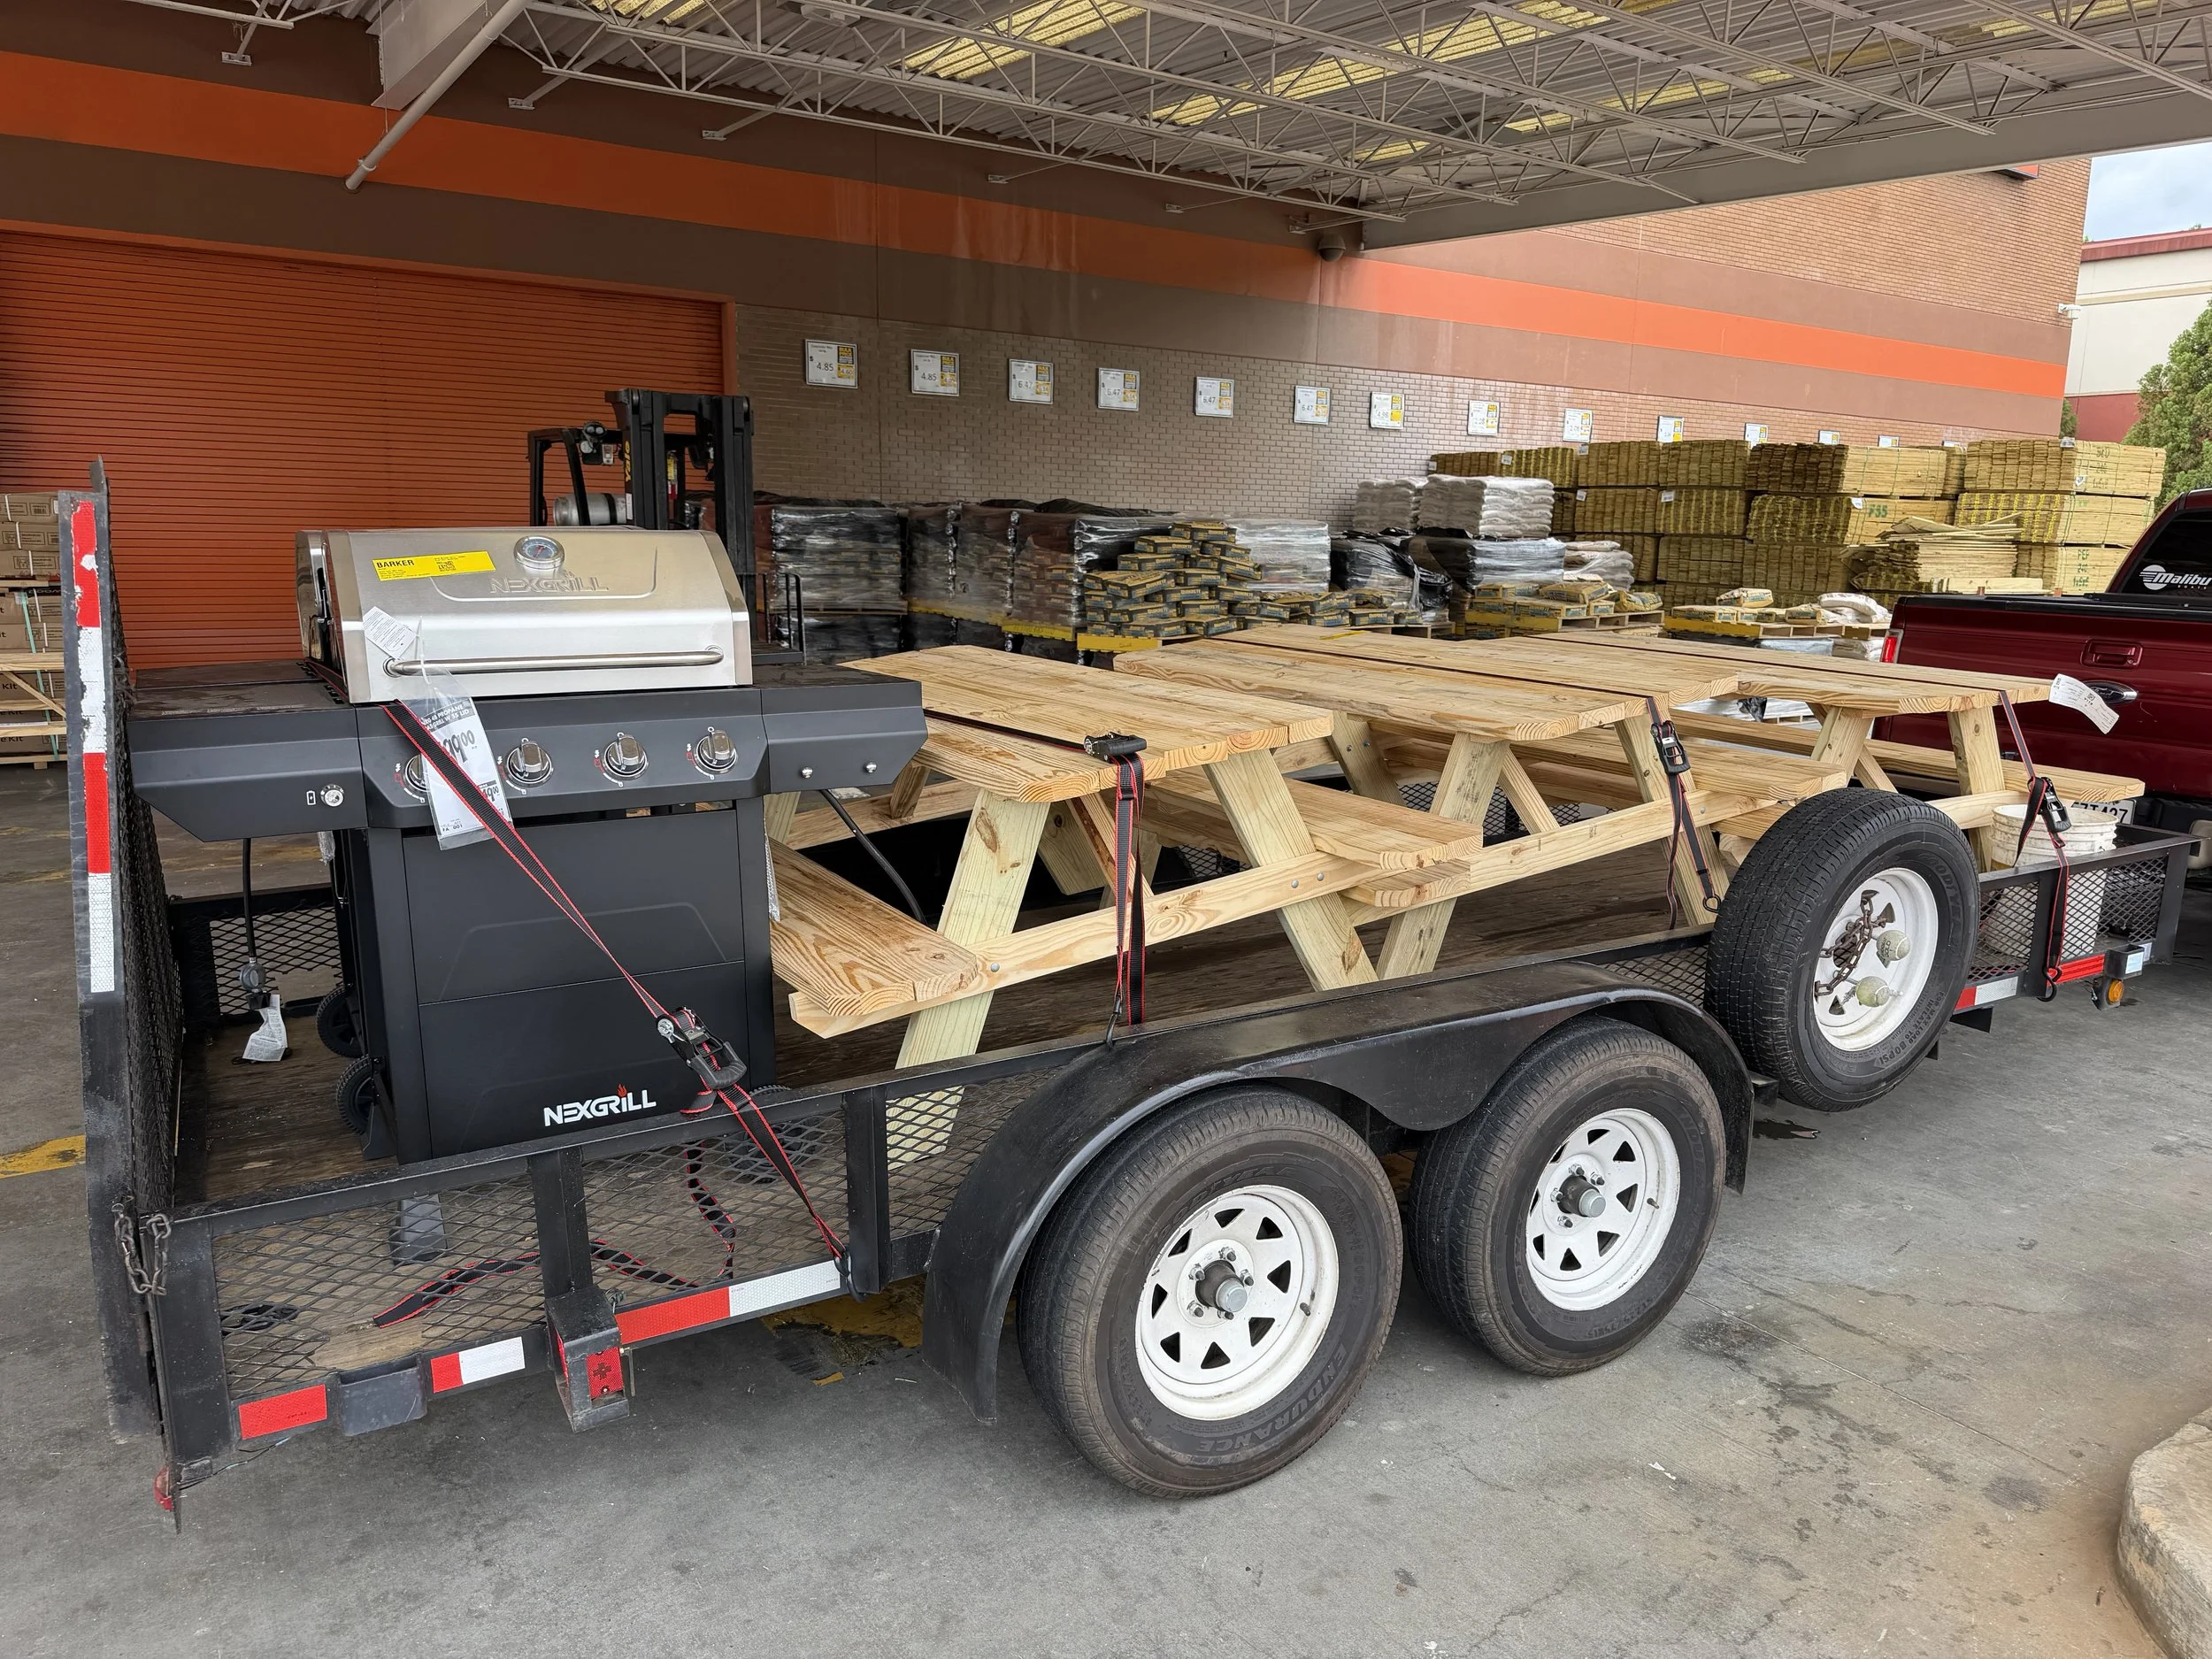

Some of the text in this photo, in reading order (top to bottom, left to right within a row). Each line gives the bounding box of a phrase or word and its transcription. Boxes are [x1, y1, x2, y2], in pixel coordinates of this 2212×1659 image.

[817, 362, 834, 372] 4.85
[921, 373, 937, 381] 4.85
[1018, 380, 1033, 389] 6.47
[376, 559, 415, 568] BARKER
[489, 576, 609, 594] NEXGRILL
[3, 680, 18, 690] Kit
[437, 704, 464, 718] PROPANE
[1914, 999, 1934, 1029] INFLATE
[543, 1088, 657, 1127] NEXGRILL
[1195, 1342, 1348, 1452] ENDURANCE
